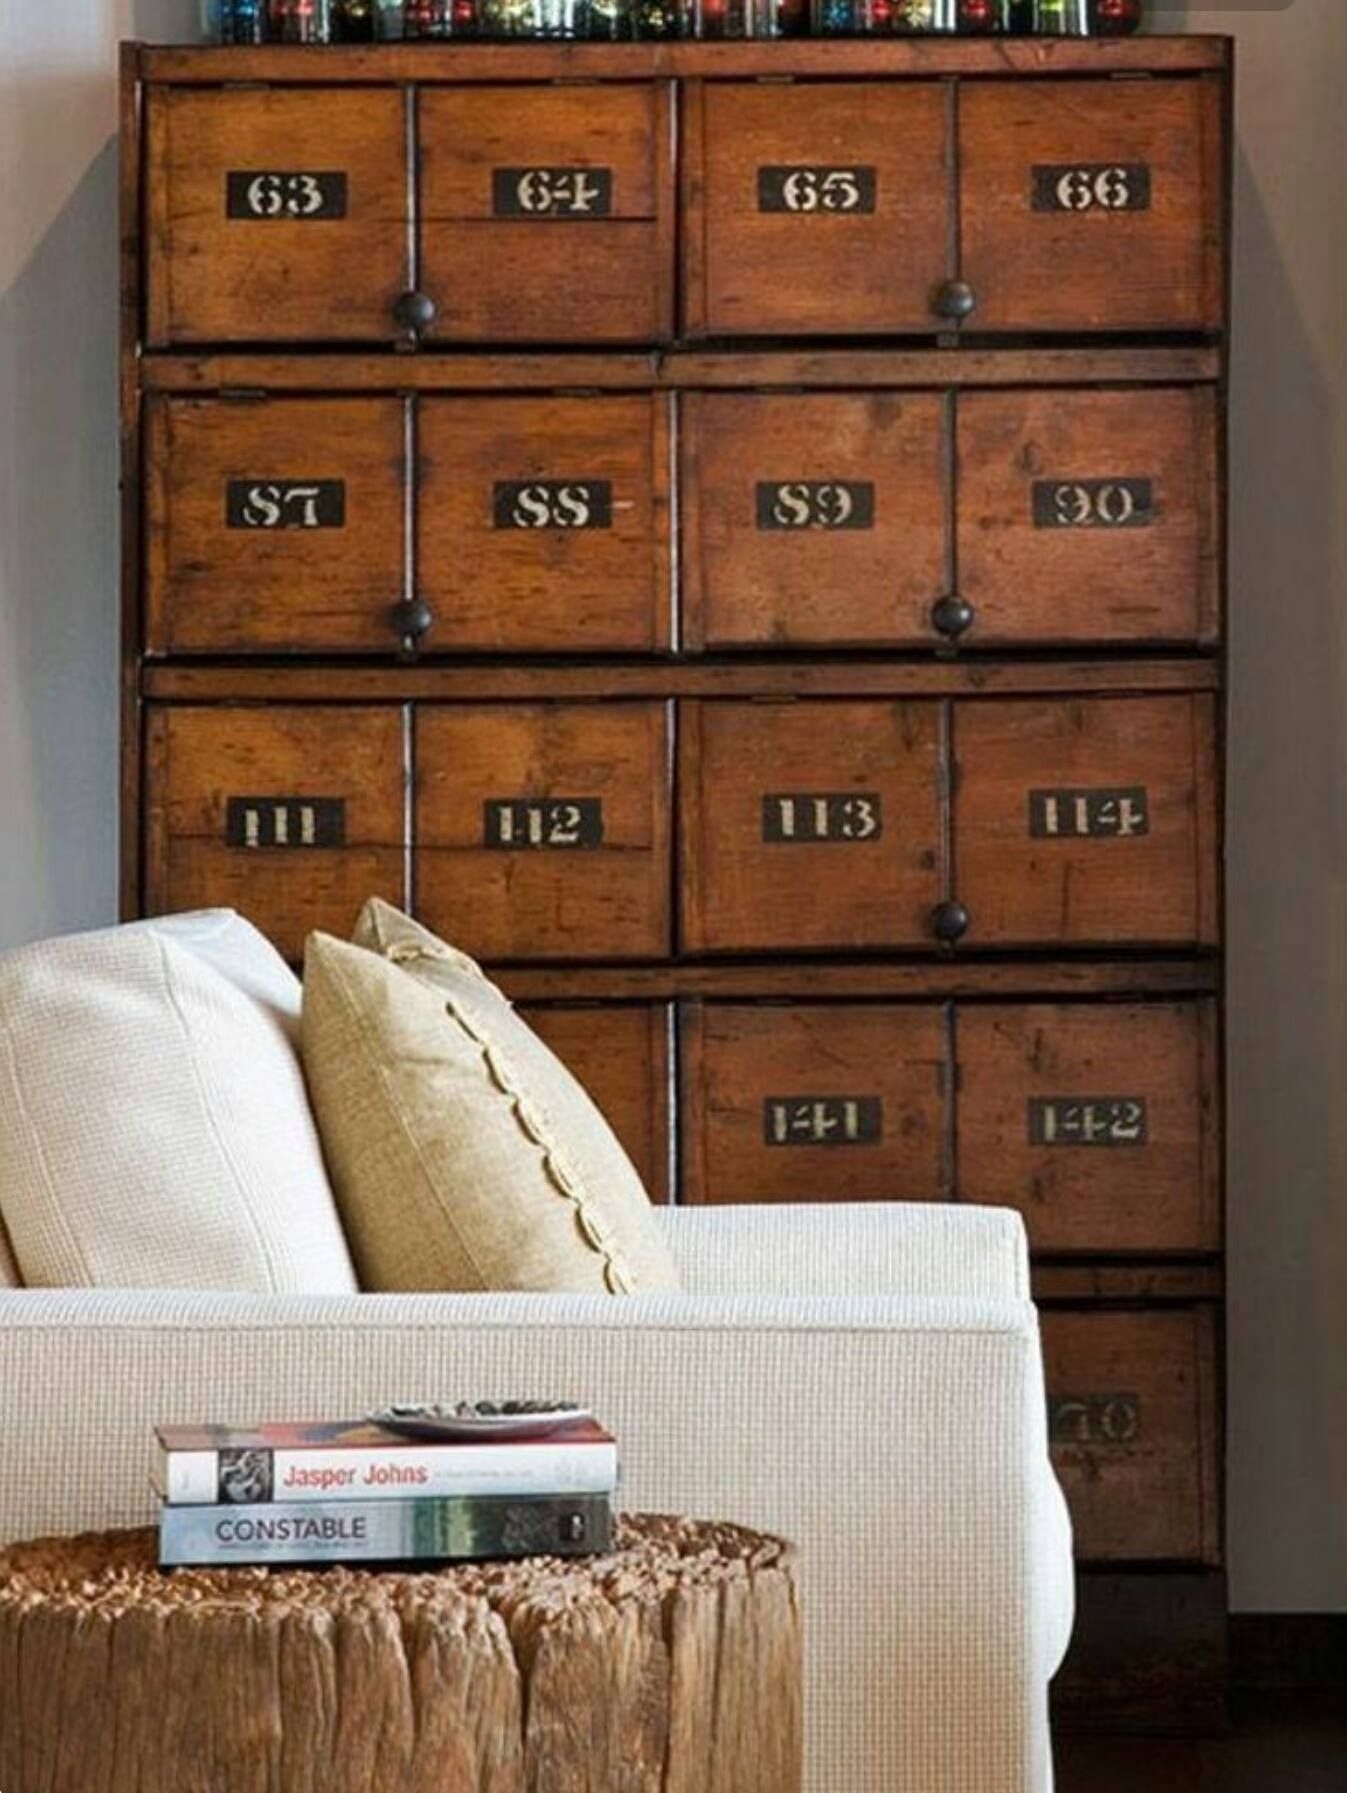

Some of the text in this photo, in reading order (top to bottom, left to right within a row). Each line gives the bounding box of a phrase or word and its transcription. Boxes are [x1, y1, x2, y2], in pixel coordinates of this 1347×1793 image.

[249, 177, 322, 214] 63
[519, 173, 600, 210] 64
[783, 172, 859, 210] 65
[1056, 170, 1130, 209] 66
[244, 487, 319, 525] 87
[515, 487, 590, 526] 88
[774, 486, 851, 525] 89
[1055, 488, 1132, 524] 90
[246, 807, 314, 847] 111
[501, 806, 580, 843] 112
[780, 799, 875, 836] 113
[1046, 797, 1141, 835] 114
[774, 1104, 858, 1142] 141
[1046, 1105, 1141, 1140] 142
[1056, 1402, 1137, 1439] 70
[283, 1462, 428, 1488] Jasper Johns
[216, 1517, 367, 1542] CONSTABLE
